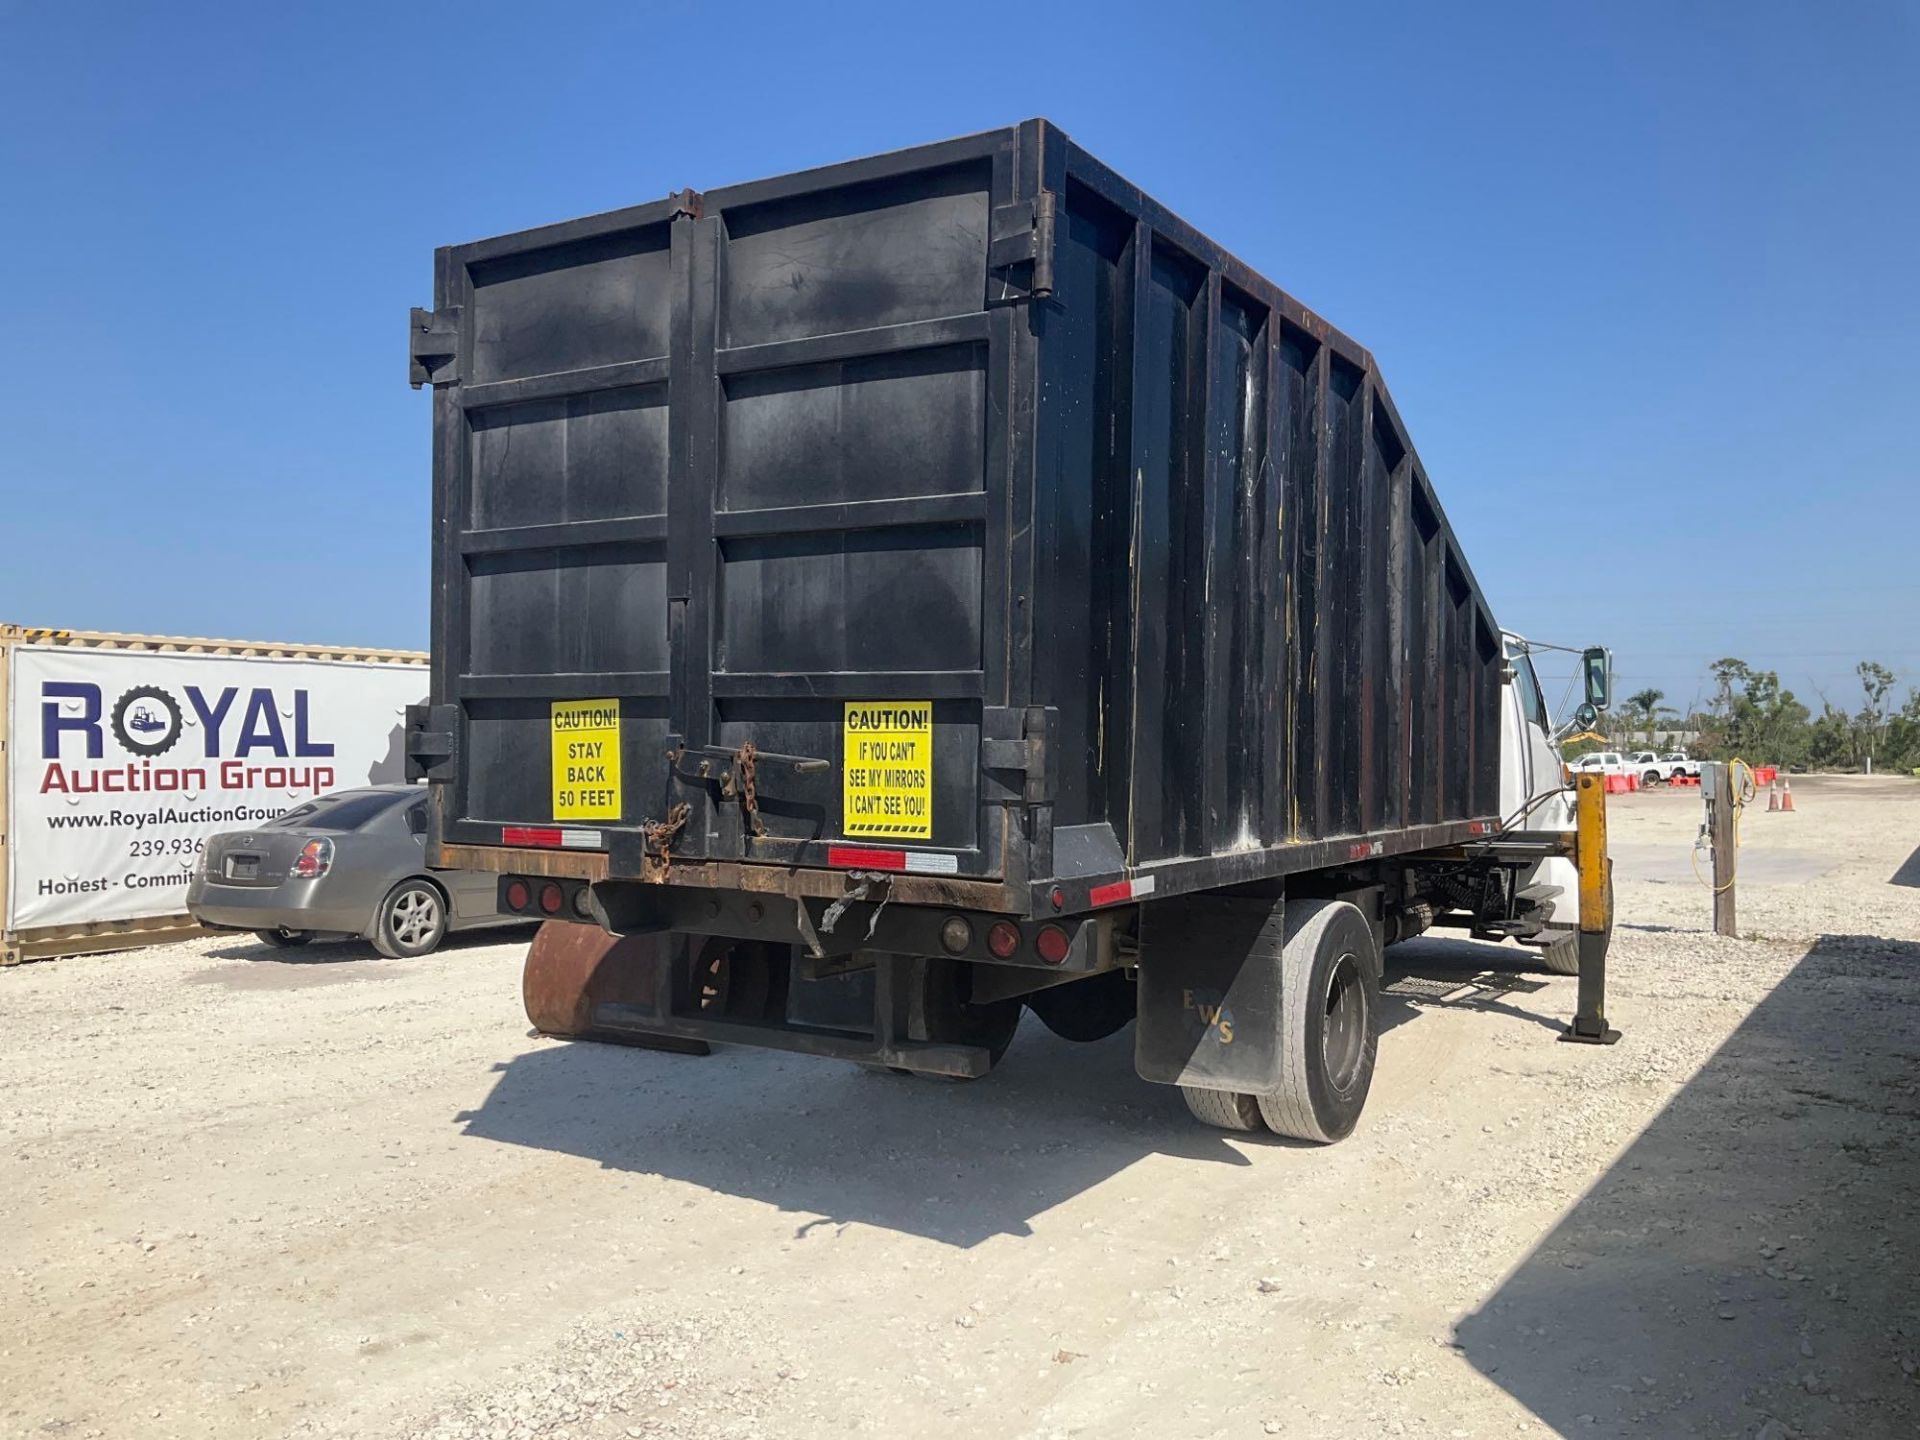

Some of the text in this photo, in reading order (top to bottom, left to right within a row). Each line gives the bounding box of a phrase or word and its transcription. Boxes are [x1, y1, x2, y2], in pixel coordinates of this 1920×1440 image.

[41, 681, 335, 759] ROYAL
[555, 709, 616, 729] CAUTION!
[848, 710, 928, 730] CAUTION!
[569, 742, 603, 759] STAY
[859, 742, 915, 761] IF YOU CAN'T
[40, 759, 335, 795] Auction Group
[567, 766, 605, 782] BACK
[850, 769, 925, 789] SEE MY MIRRORS
[559, 790, 615, 806] 50 FEET
[855, 795, 881, 814] CAN'T
[884, 796, 900, 815] SEE
[904, 797, 925, 816] YOU!
[129, 838, 204, 857] 239.936
[38, 876, 107, 895] Honest
[124, 870, 195, 889] Commit
